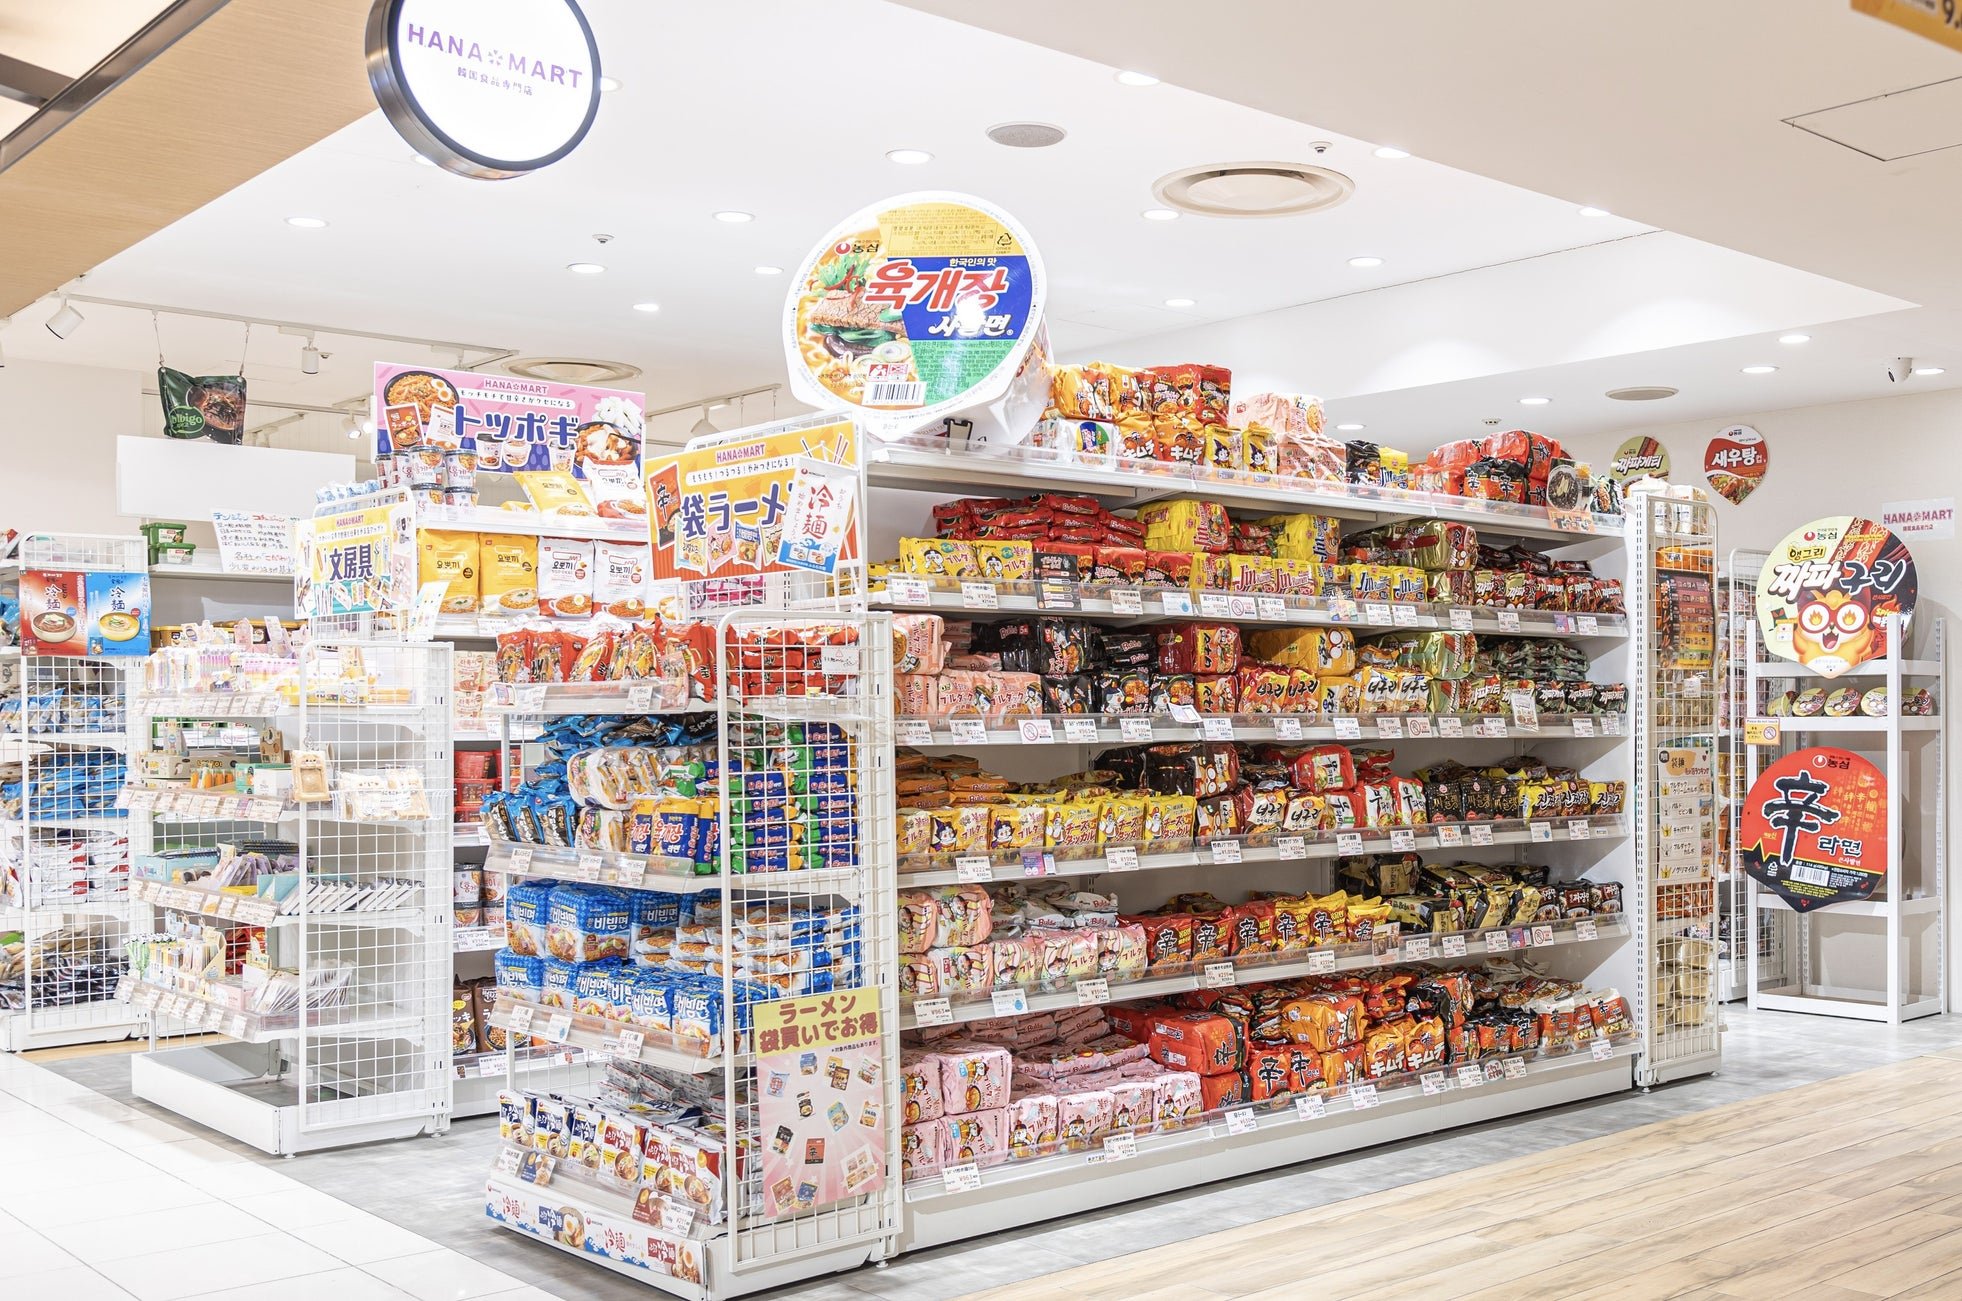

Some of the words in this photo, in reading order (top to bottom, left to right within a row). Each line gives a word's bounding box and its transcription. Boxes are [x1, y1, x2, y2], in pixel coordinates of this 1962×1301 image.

[408, 23, 483, 62] HANA
[509, 53, 582, 88] MART
[852, 243, 879, 253] 농심
[987, 258, 997, 266] 맛
[865, 259, 1009, 311] 육개장
[928, 315, 1011, 337] 사면
[485, 380, 512, 390] HANA
[454, 405, 580, 447] トッポギ
[717, 450, 738, 463] HANA
[743, 444, 765, 457] MART
[1171, 445, 1202, 460] キムチ
[1711, 447, 1757, 468] 새우탕
[1617, 455, 1662, 475] 짜파게티
[1467, 470, 1481, 491] 辛
[1499, 473, 1514, 496] 辛
[682, 482, 794, 538] 袋ラーメ
[1884, 513, 1913, 524] HANA
[1923, 509, 1953, 520] MART
[1817, 532, 1837, 540] 농심
[330, 543, 373, 582] 文房具
[1790, 547, 1825, 558] 앵그리
[1238, 564, 1255, 591] Jin
[1274, 568, 1292, 593] Jin
[1768, 560, 1906, 603] 짜파구리
[1256, 682, 1287, 697] 너구리
[1288, 680, 1318, 696] 너구리
[1367, 680, 1397, 694] 너구리
[1827, 758, 1850, 769] 농심
[1256, 802, 1284, 816] 너구리
[1291, 809, 1319, 823] 너구리
[1762, 770, 1841, 866] 辛
[1817, 836, 1862, 856] 라면
[594, 913, 628, 930] 비빔면
[647, 907, 678, 923] 비빔면
[1277, 911, 1297, 941] 辛
[1314, 912, 1332, 940] 辛
[1197, 925, 1217, 952] 辛
[1239, 916, 1259, 948] 辛
[1157, 929, 1177, 958] 辛
[779, 995, 856, 1024] ラーメン
[759, 1012, 878, 1053] 袋買いでお得
[1370, 1053, 1405, 1078] キムチ
[1407, 1042, 1445, 1070] キムチ
[1259, 1056, 1285, 1096] 辛
[1290, 1050, 1311, 1087] 辛
